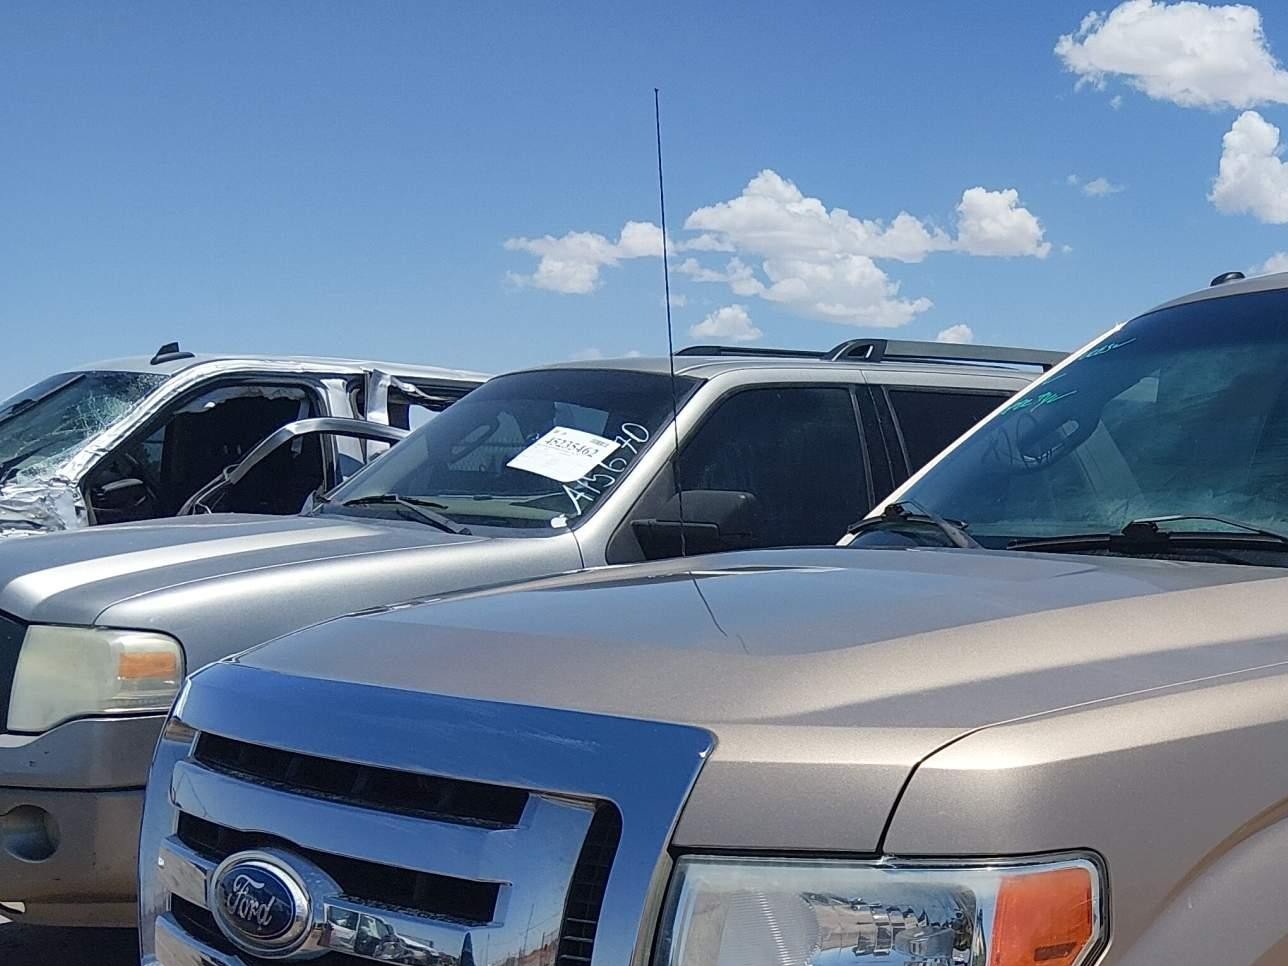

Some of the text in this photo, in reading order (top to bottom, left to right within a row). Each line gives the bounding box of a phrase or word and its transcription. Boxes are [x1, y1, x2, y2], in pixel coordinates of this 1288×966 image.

[545, 437, 599, 458] 45235462
[562, 422, 650, 516] A15670
[228, 874, 276, 927] Ford
